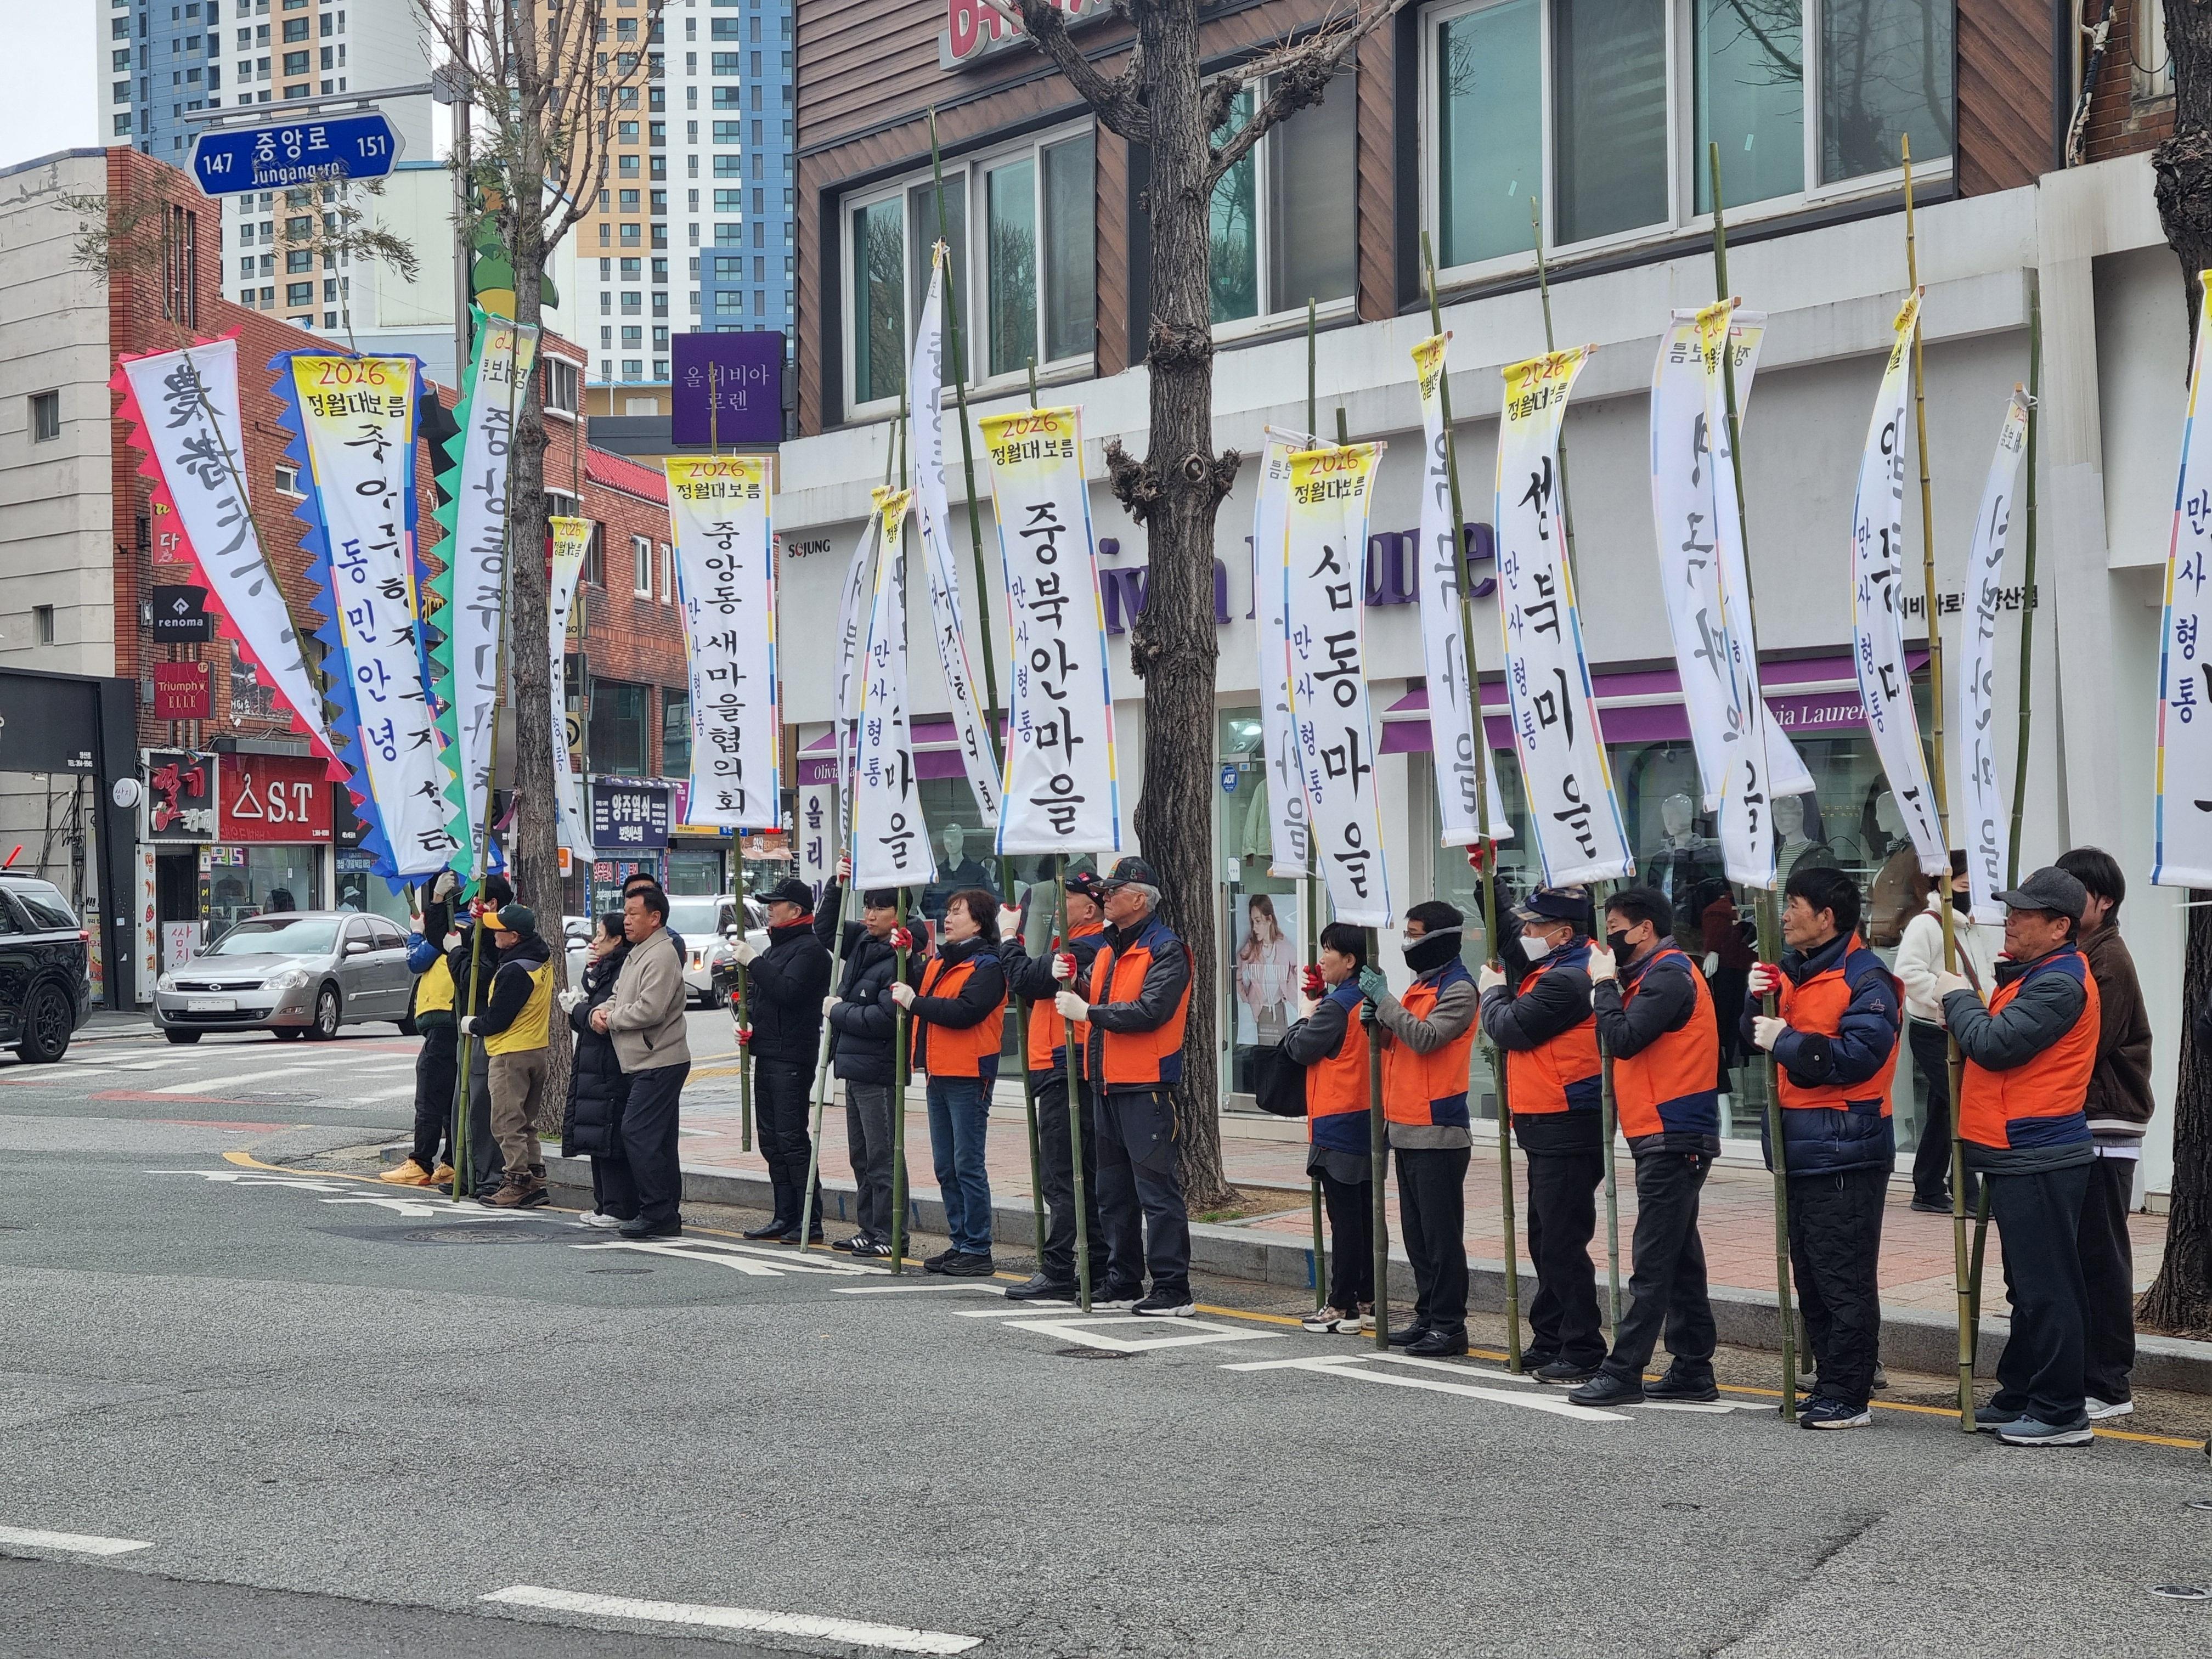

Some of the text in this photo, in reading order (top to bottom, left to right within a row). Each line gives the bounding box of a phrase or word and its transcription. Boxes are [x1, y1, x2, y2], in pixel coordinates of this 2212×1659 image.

[203, 127, 385, 175] 147 중앙로 151
[318, 361, 386, 386] 2026
[682, 363, 770, 387] 올리비아
[1521, 353, 1566, 390] 2026
[307, 390, 407, 417] 정월대보름
[705, 390, 748, 411] 로렌
[1001, 412, 1058, 438] 2026
[990, 439, 1075, 466] 정월대보름
[1308, 448, 1359, 475] 2026
[689, 460, 745, 478] 2026
[676, 482, 761, 500] 정월대보름
[1295, 476, 1365, 504] 정월대보름
[559, 522, 581, 537] 2026
[554, 540, 582, 558] 정월보름
[703, 521, 742, 616] 중앙동
[2171, 488, 2211, 724] 만사형통
[158, 618, 204, 627] renoma
[1857, 516, 1885, 733] 만사형통
[337, 538, 397, 763] 동민안녕
[1011, 575, 1034, 744] 만사형통
[1504, 550, 1537, 751] 만사형통
[687, 596, 705, 738] 만사형통
[157, 681, 198, 692] Triumph
[168, 695, 196, 708] ELLE
[863, 639, 889, 788] 만사형통
[1293, 623, 1323, 805] 만사형통
[1223, 774, 1235, 784] ADT
[267, 781, 313, 823] S.T
[611, 793, 650, 822] 양주열쇠
[618, 825, 643, 842] 보안시스템
